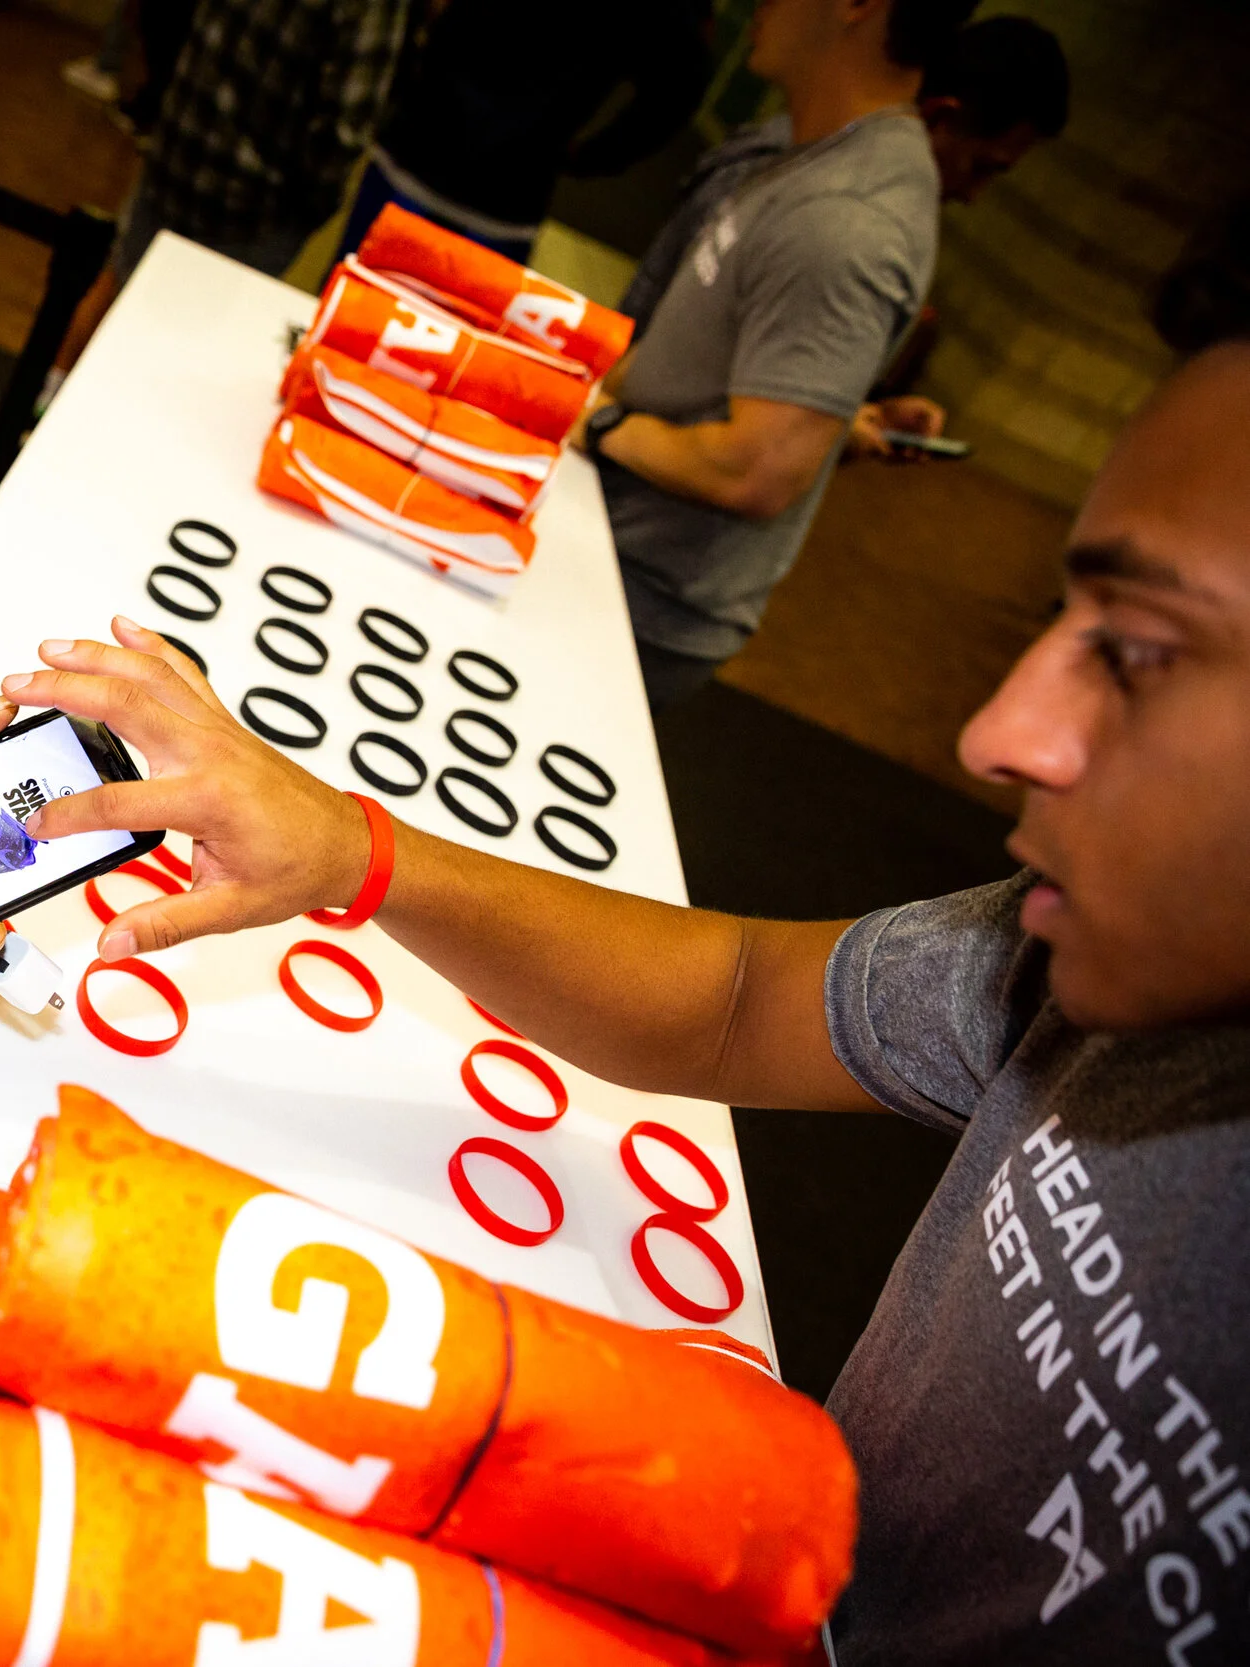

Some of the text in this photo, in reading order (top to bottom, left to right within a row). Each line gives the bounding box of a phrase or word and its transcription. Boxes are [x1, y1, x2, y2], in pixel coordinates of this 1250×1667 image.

[983, 1156, 1042, 1299] FEET
[1016, 1300, 1074, 1393] IN
[1063, 1378, 1167, 1554] THE
[1022, 1113, 1250, 1567] HEAD IN THE
